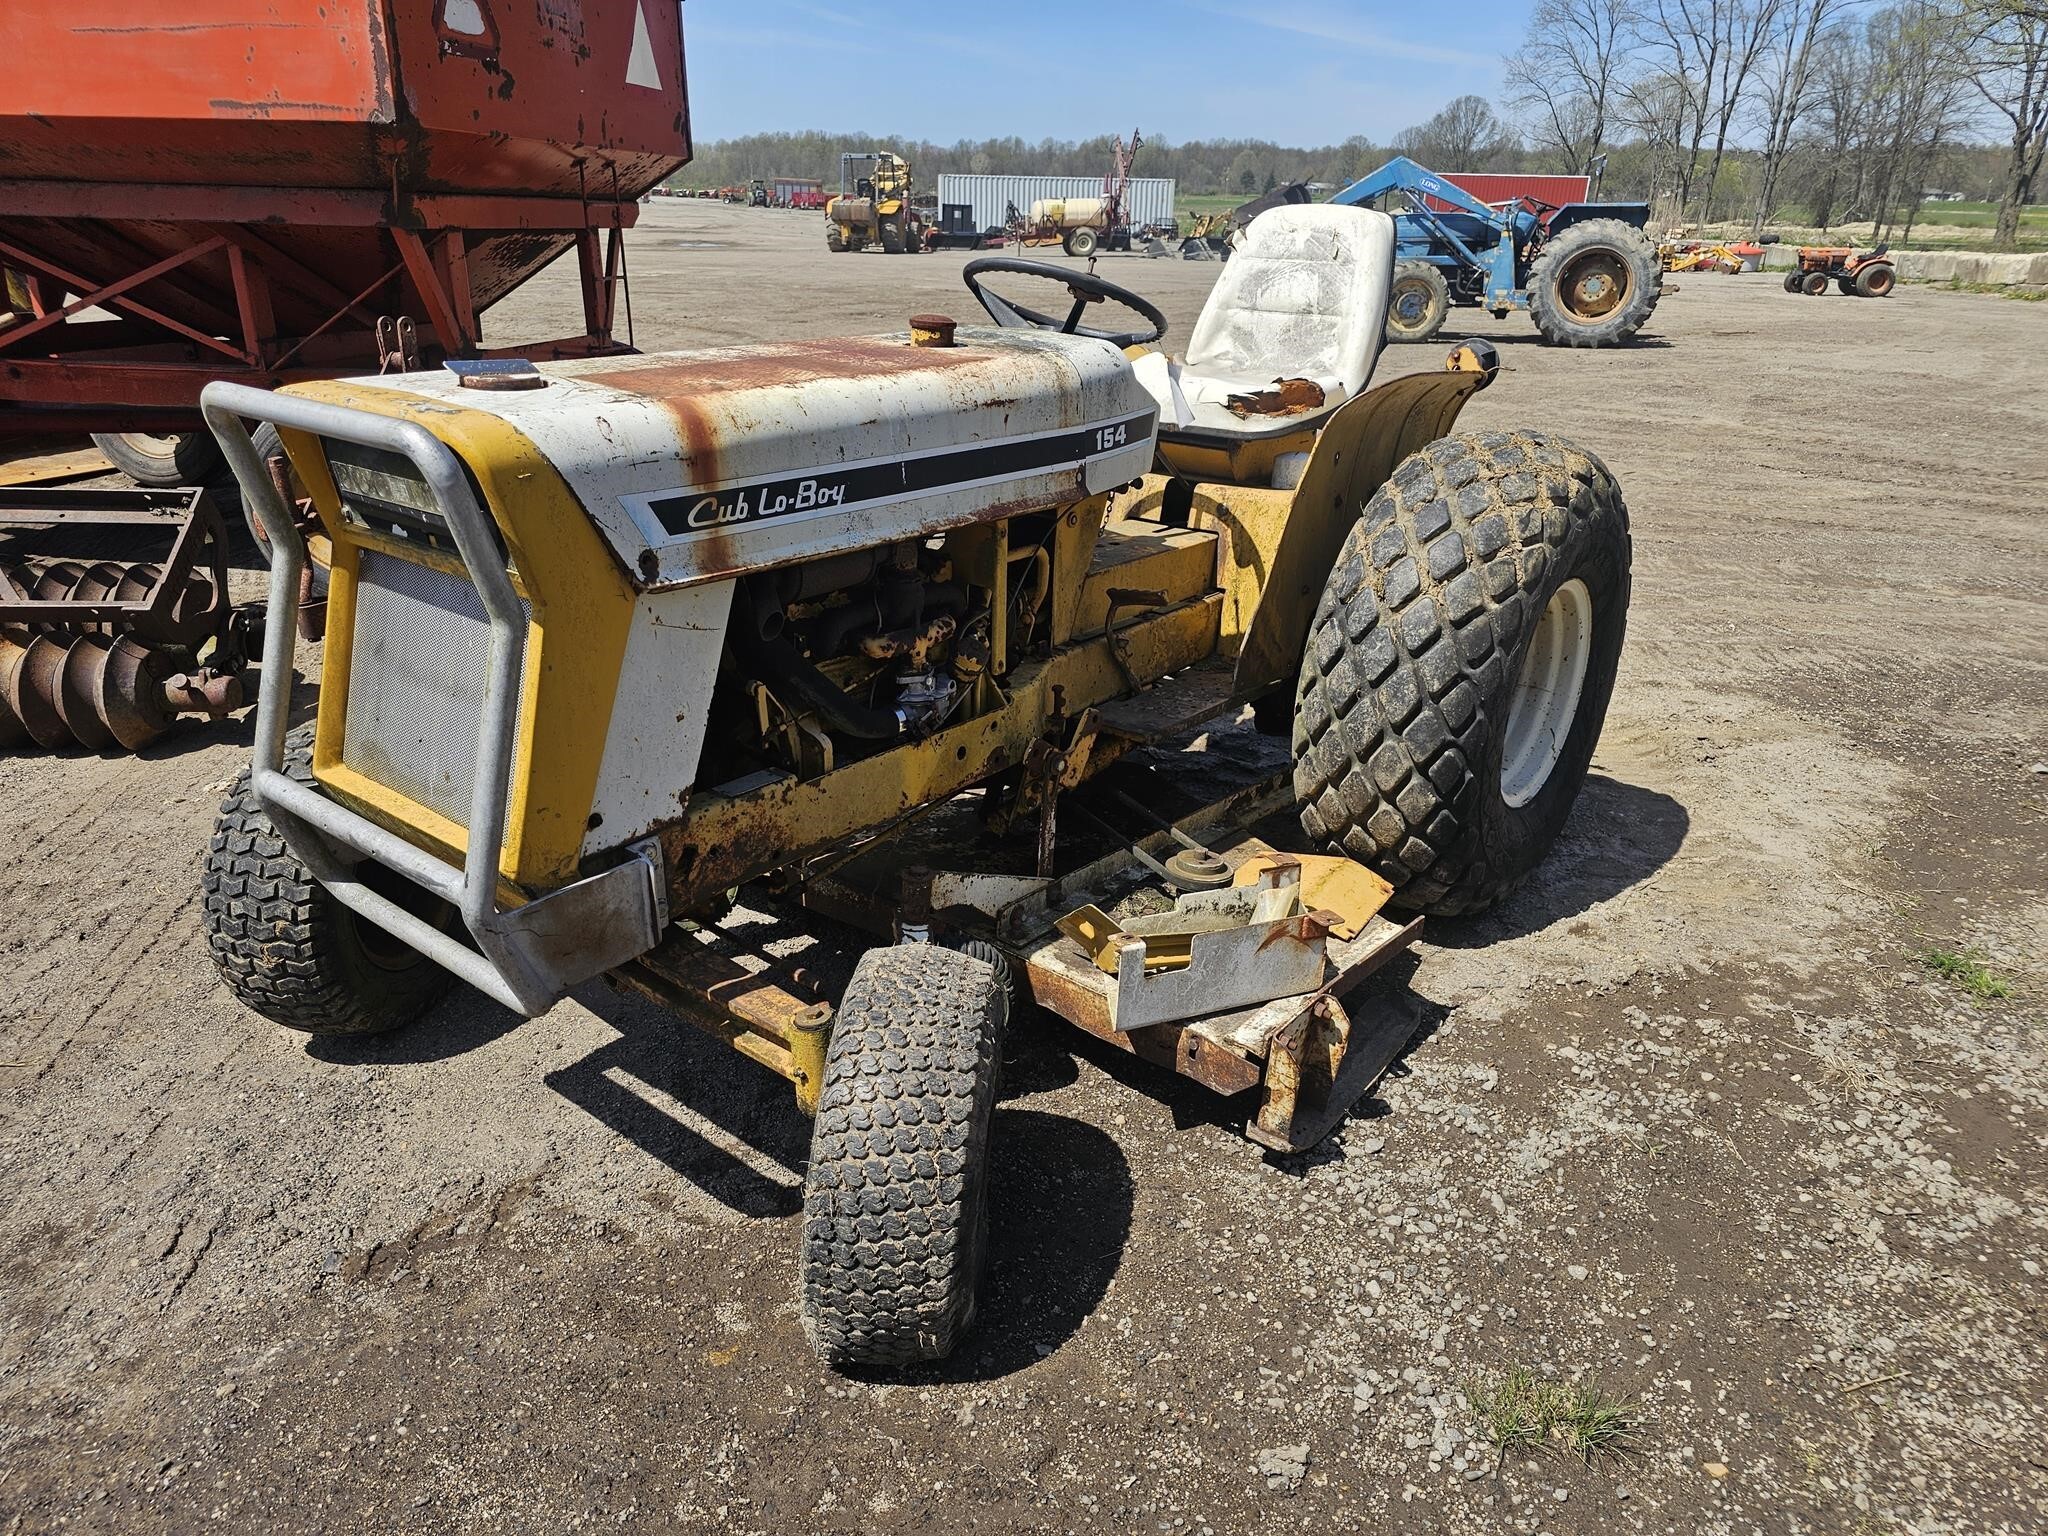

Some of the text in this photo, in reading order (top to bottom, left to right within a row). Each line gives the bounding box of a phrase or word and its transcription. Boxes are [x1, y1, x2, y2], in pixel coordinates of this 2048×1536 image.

[1421, 179, 1440, 191] LONG
[1096, 424, 1127, 451] 154
[687, 479, 846, 528] Cub Lo-Boy
